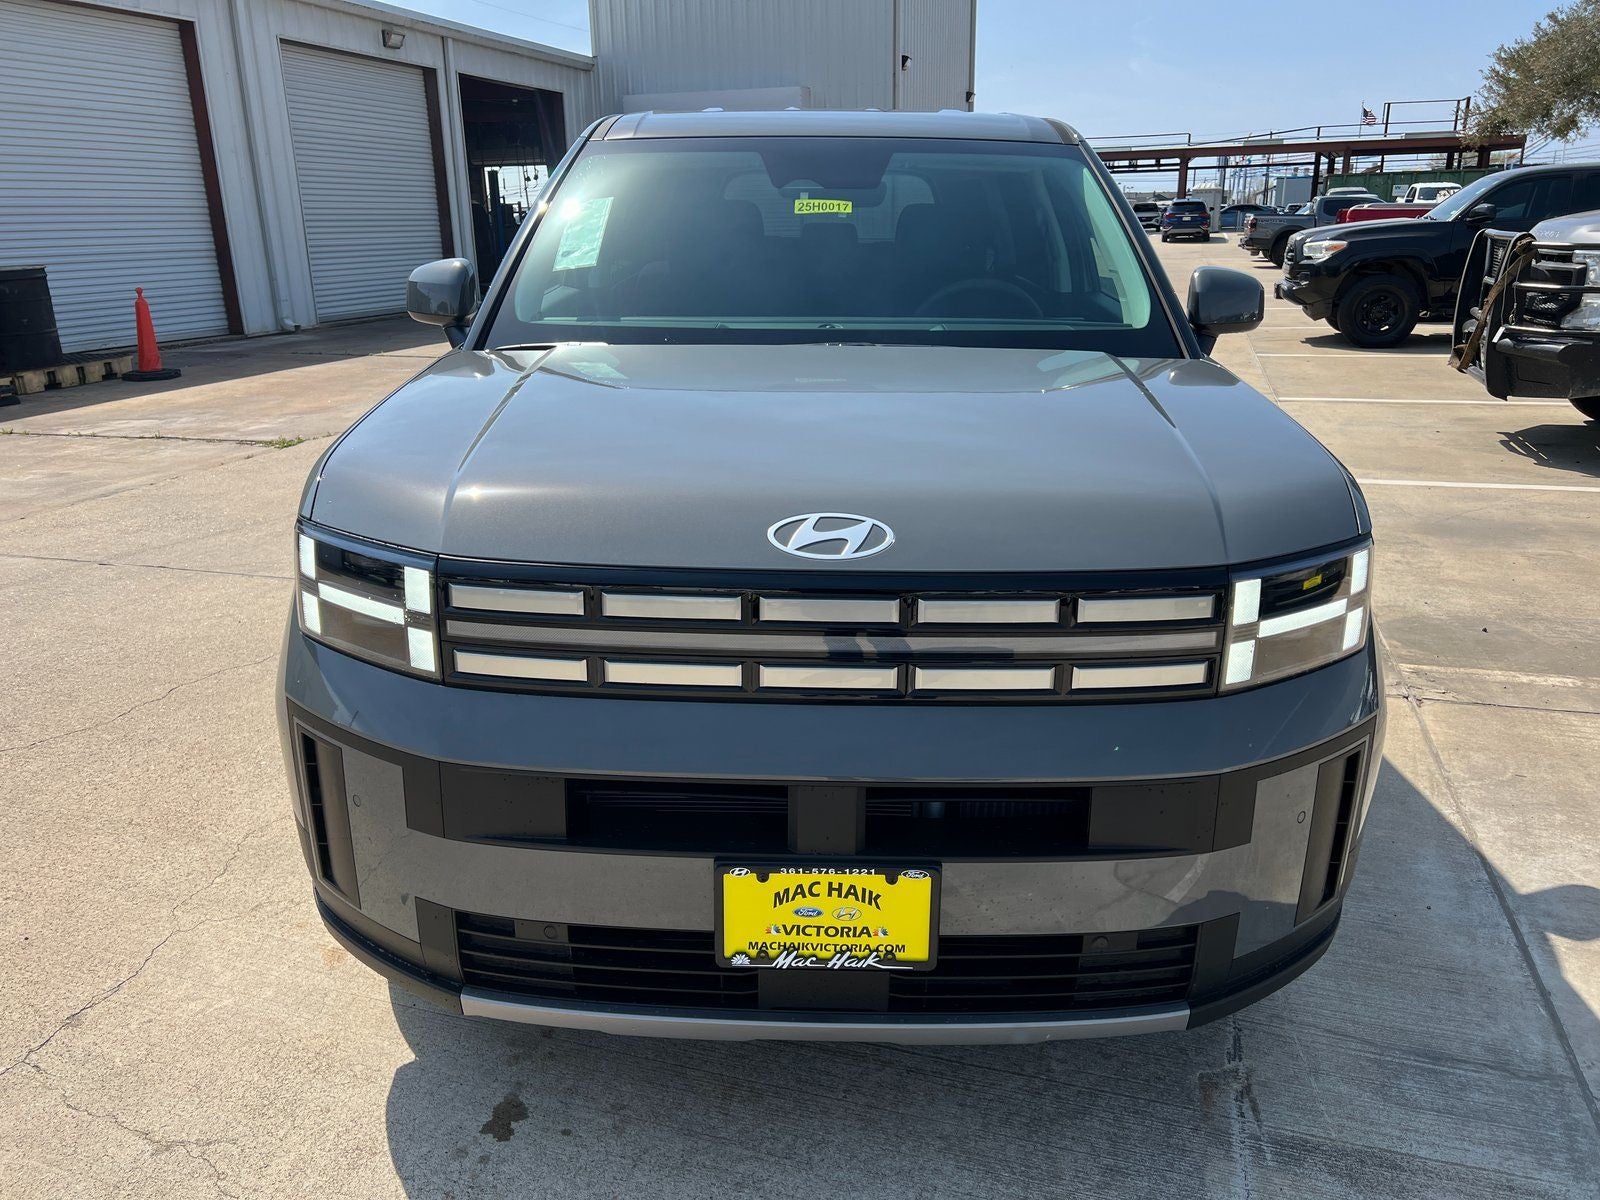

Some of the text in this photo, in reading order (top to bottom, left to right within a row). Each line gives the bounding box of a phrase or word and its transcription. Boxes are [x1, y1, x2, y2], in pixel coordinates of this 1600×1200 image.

[797, 202, 849, 211] 25H0017
[780, 867, 876, 875] 361-576-1221
[773, 881, 882, 911] MAC HAIK
[782, 924, 872, 938] VICTORIA
[770, 950, 884, 969] Mac Haik
